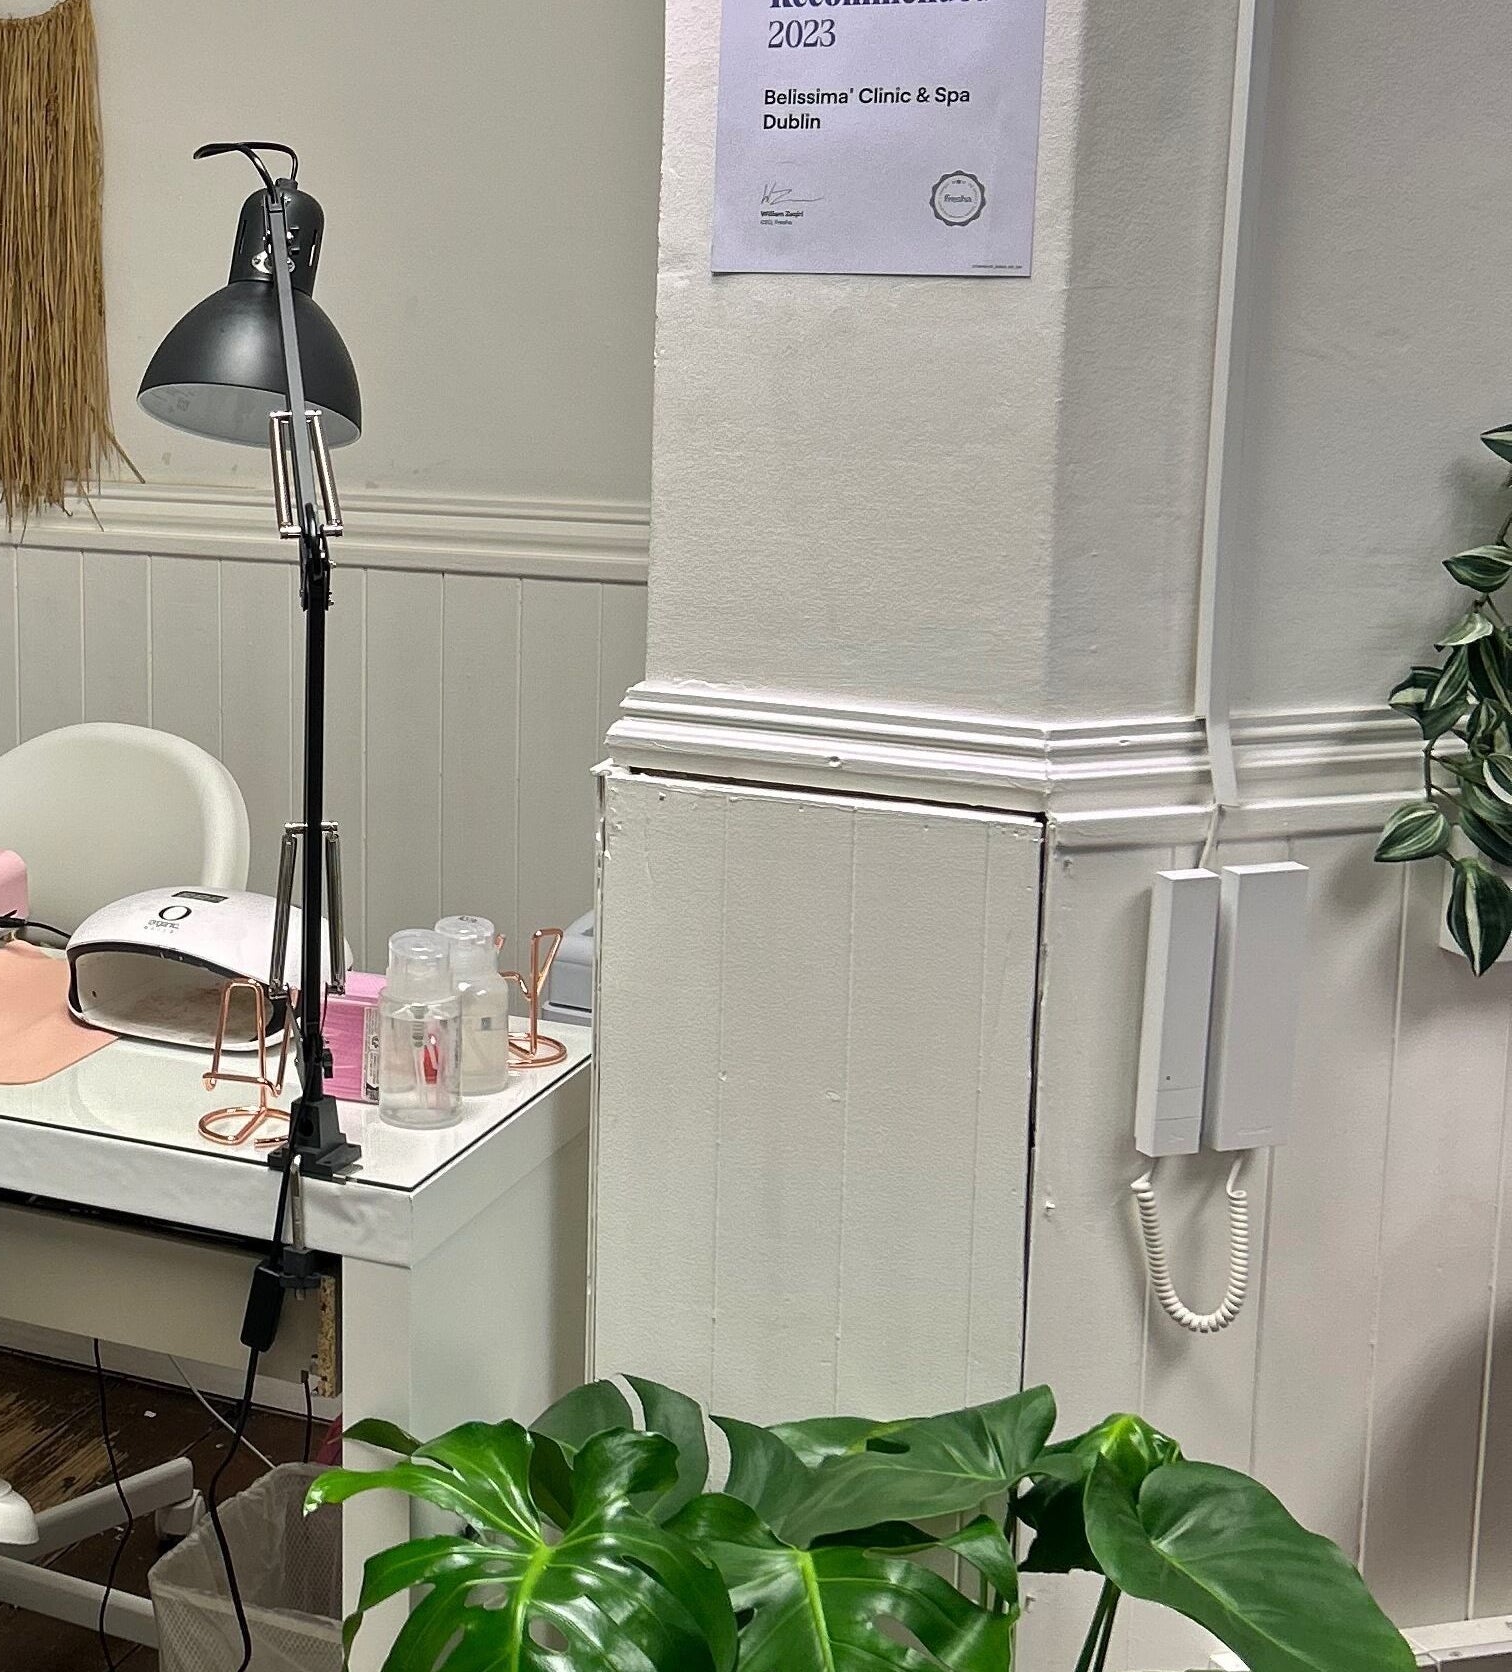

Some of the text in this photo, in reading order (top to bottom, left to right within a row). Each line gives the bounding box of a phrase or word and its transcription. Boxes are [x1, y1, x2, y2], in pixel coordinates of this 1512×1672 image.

[768, 18, 836, 48] 2023
[764, 86, 970, 107] Belissima' Clinic & Spa
[763, 113, 821, 130] Dublin
